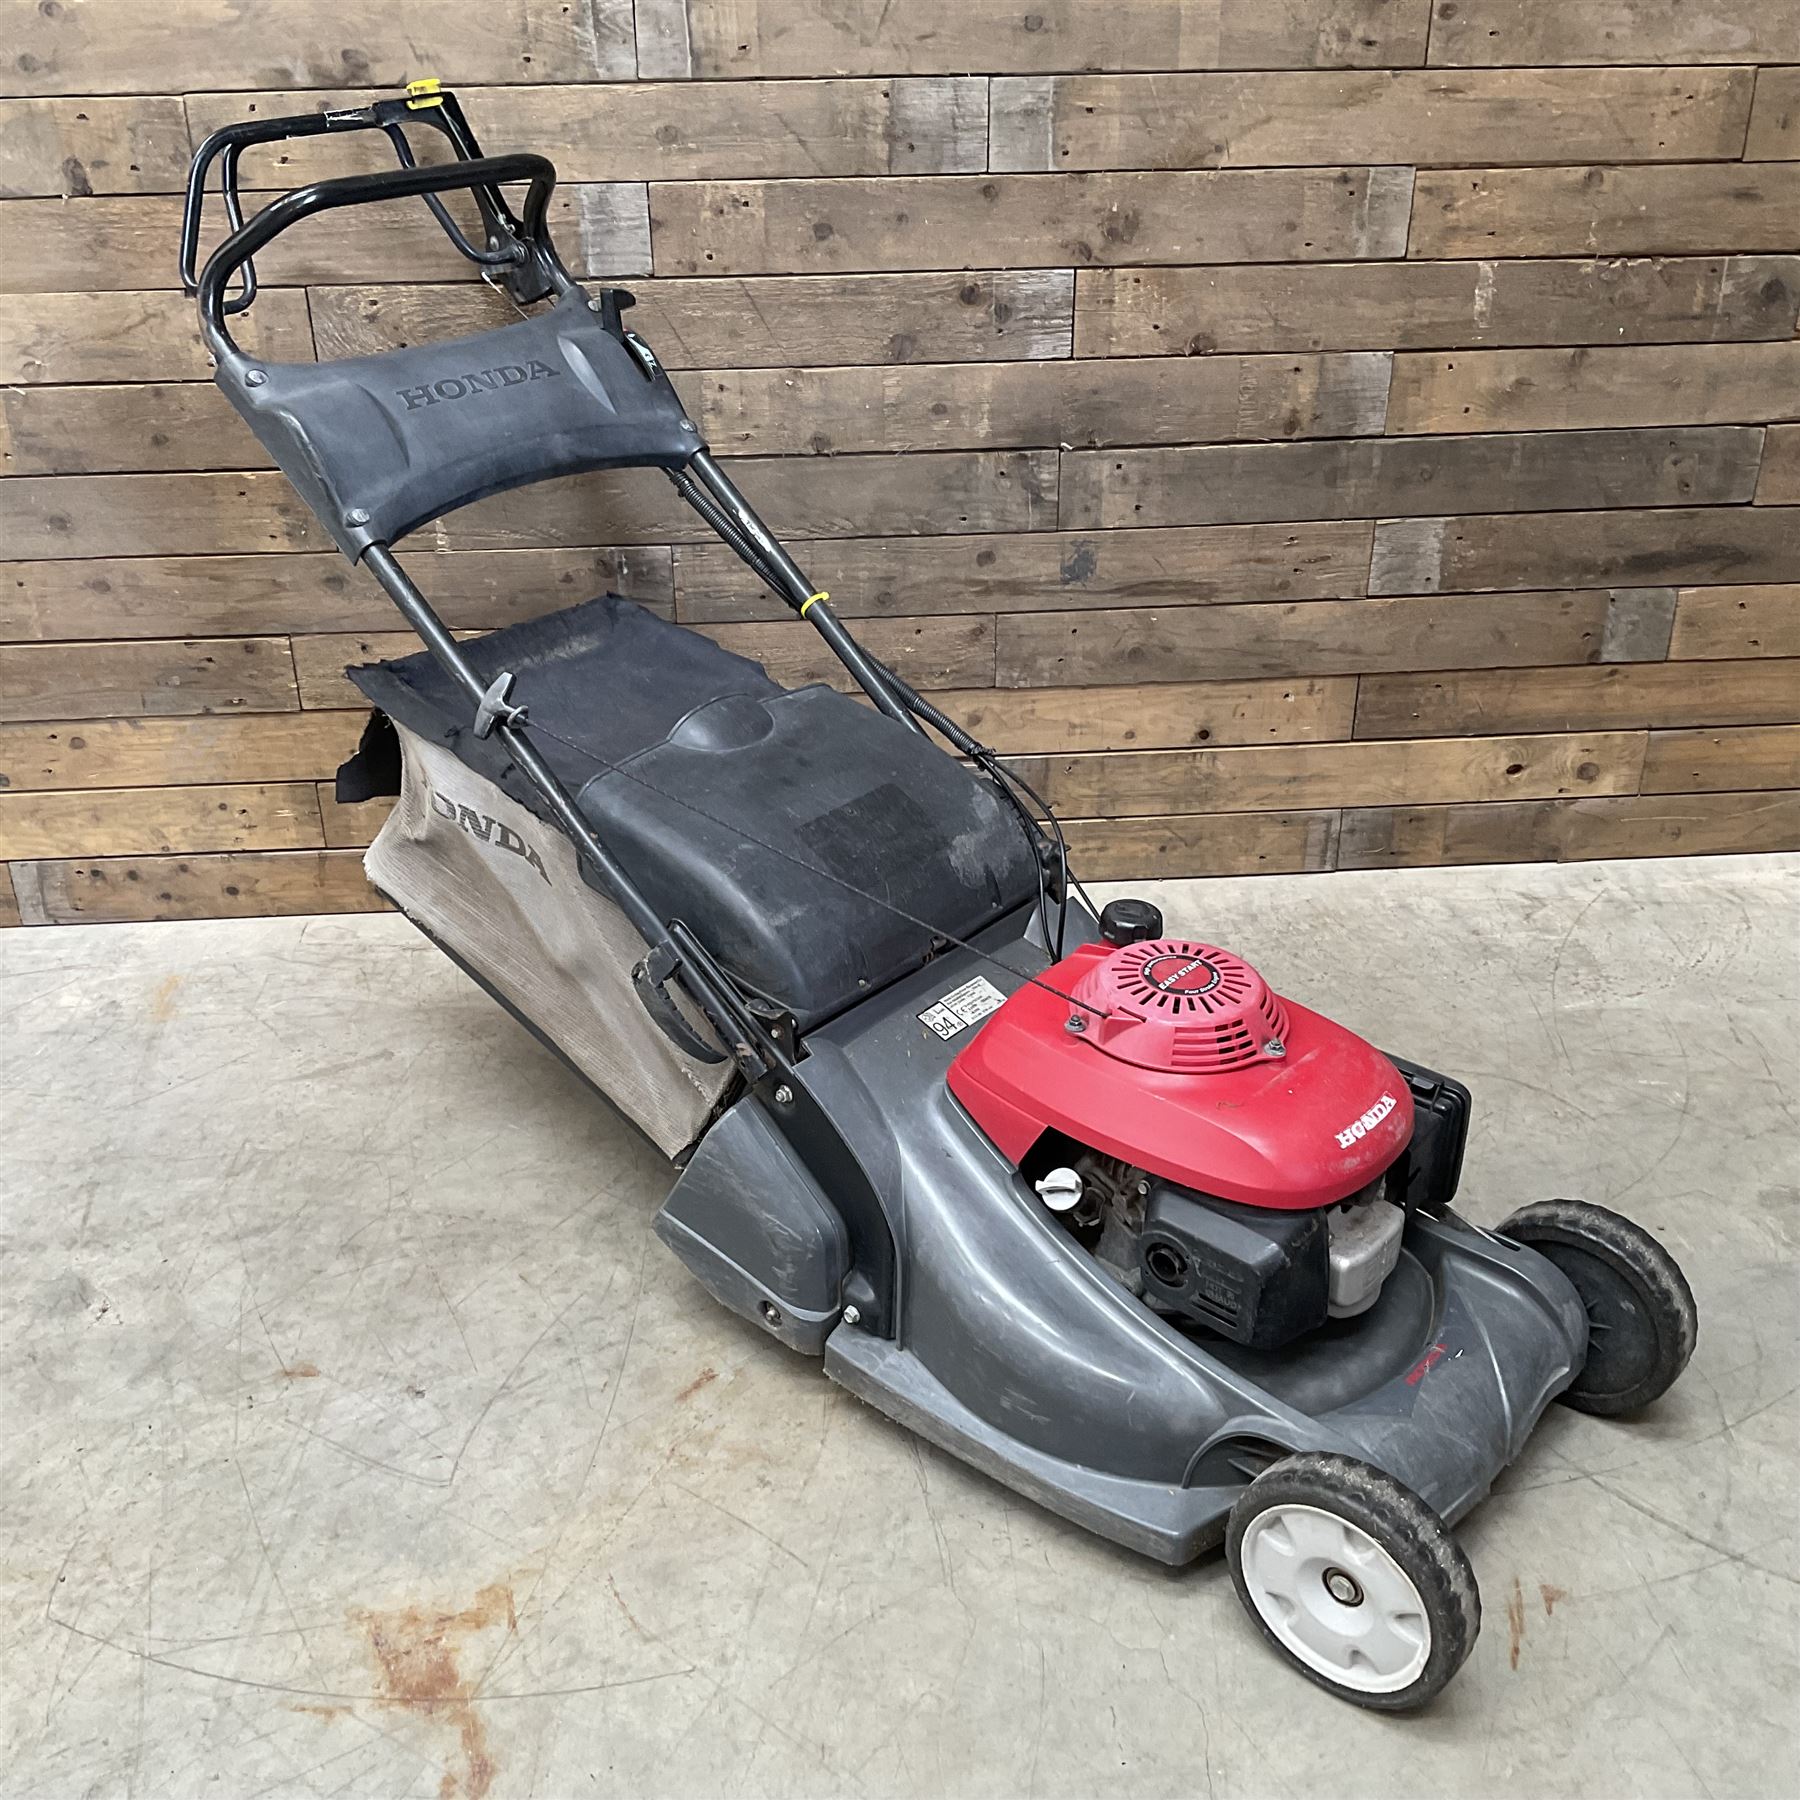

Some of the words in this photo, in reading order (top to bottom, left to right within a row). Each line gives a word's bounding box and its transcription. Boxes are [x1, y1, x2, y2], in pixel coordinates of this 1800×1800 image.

[396, 359, 561, 411] HONDA
[431, 791, 553, 887] ONDA
[1158, 972, 1180, 990] EASY
[1177, 959, 1203, 977] START
[932, 1016, 958, 1036] 94
[1334, 1094, 1397, 1150] HONDA
